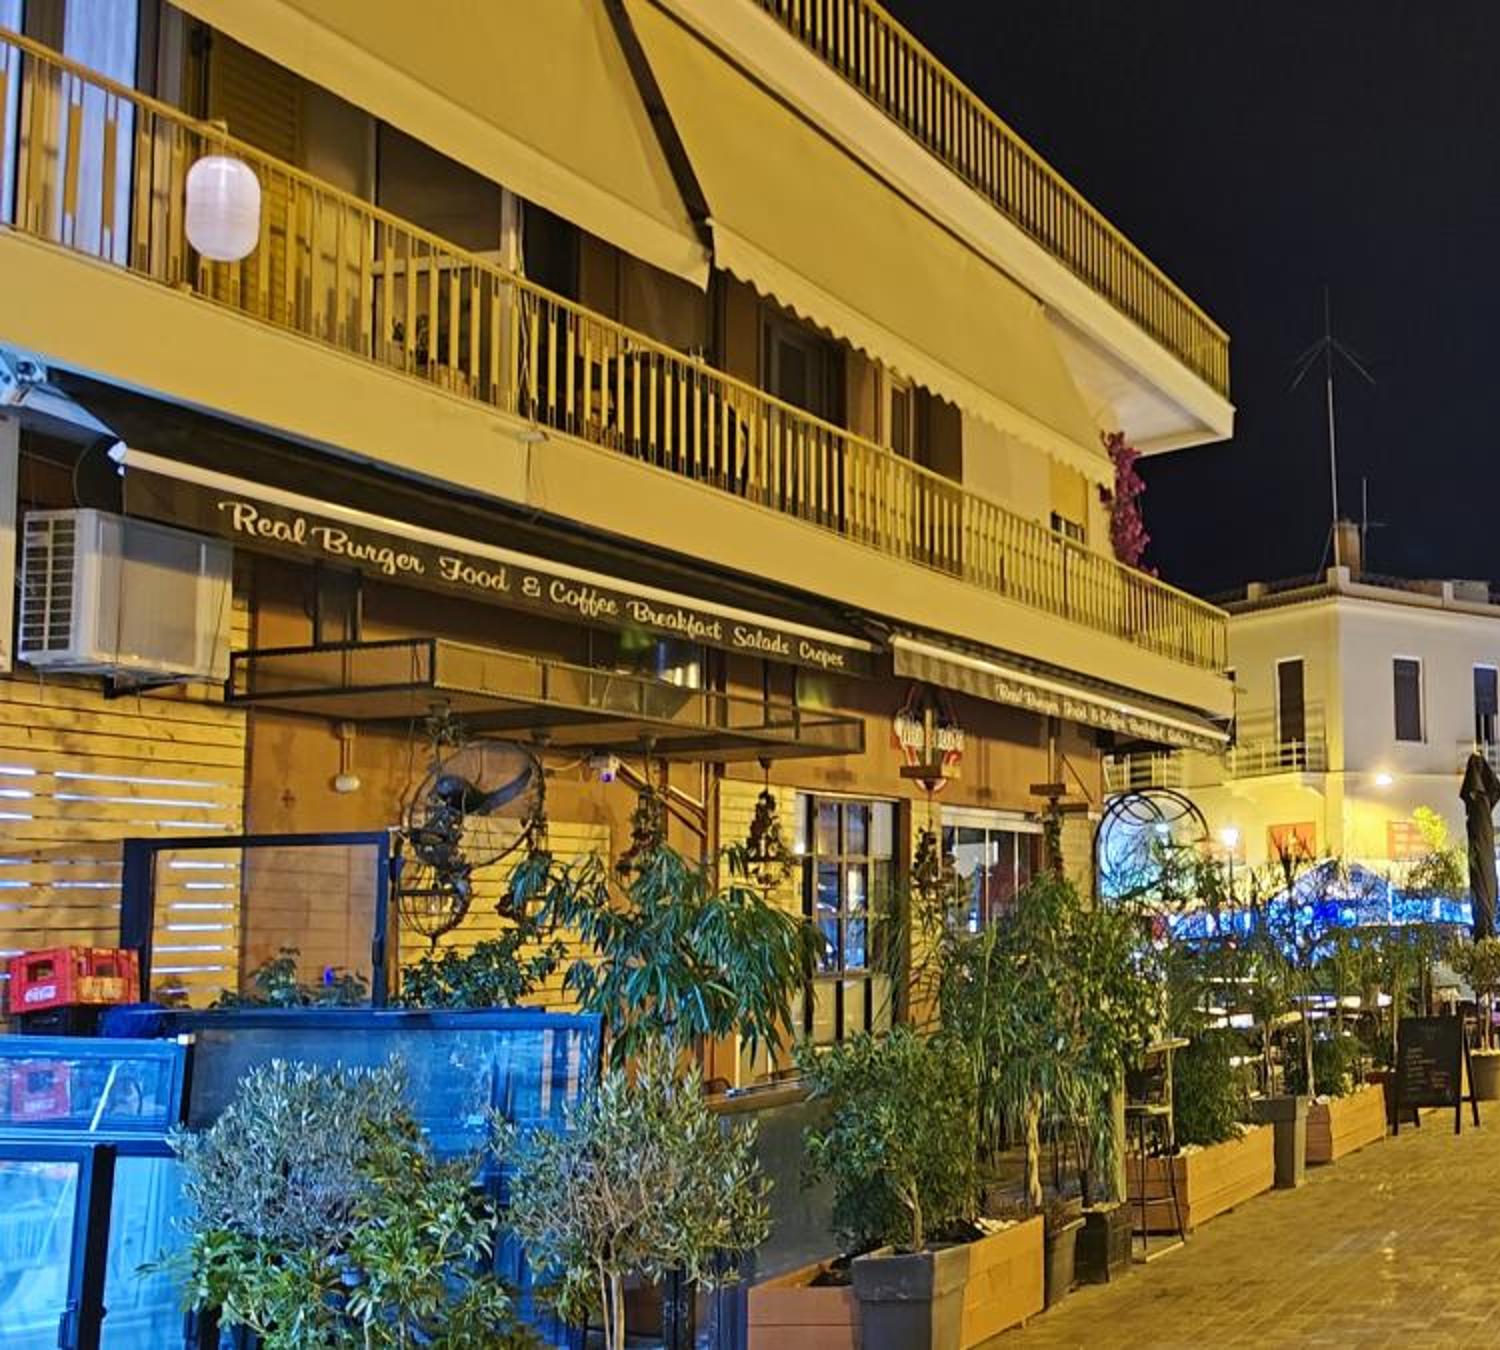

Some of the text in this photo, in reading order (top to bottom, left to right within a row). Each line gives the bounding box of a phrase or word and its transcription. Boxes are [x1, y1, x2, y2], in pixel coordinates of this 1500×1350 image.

[217, 501, 845, 669] Real Burger Food & Coffee Breakfast Salads Crepes
